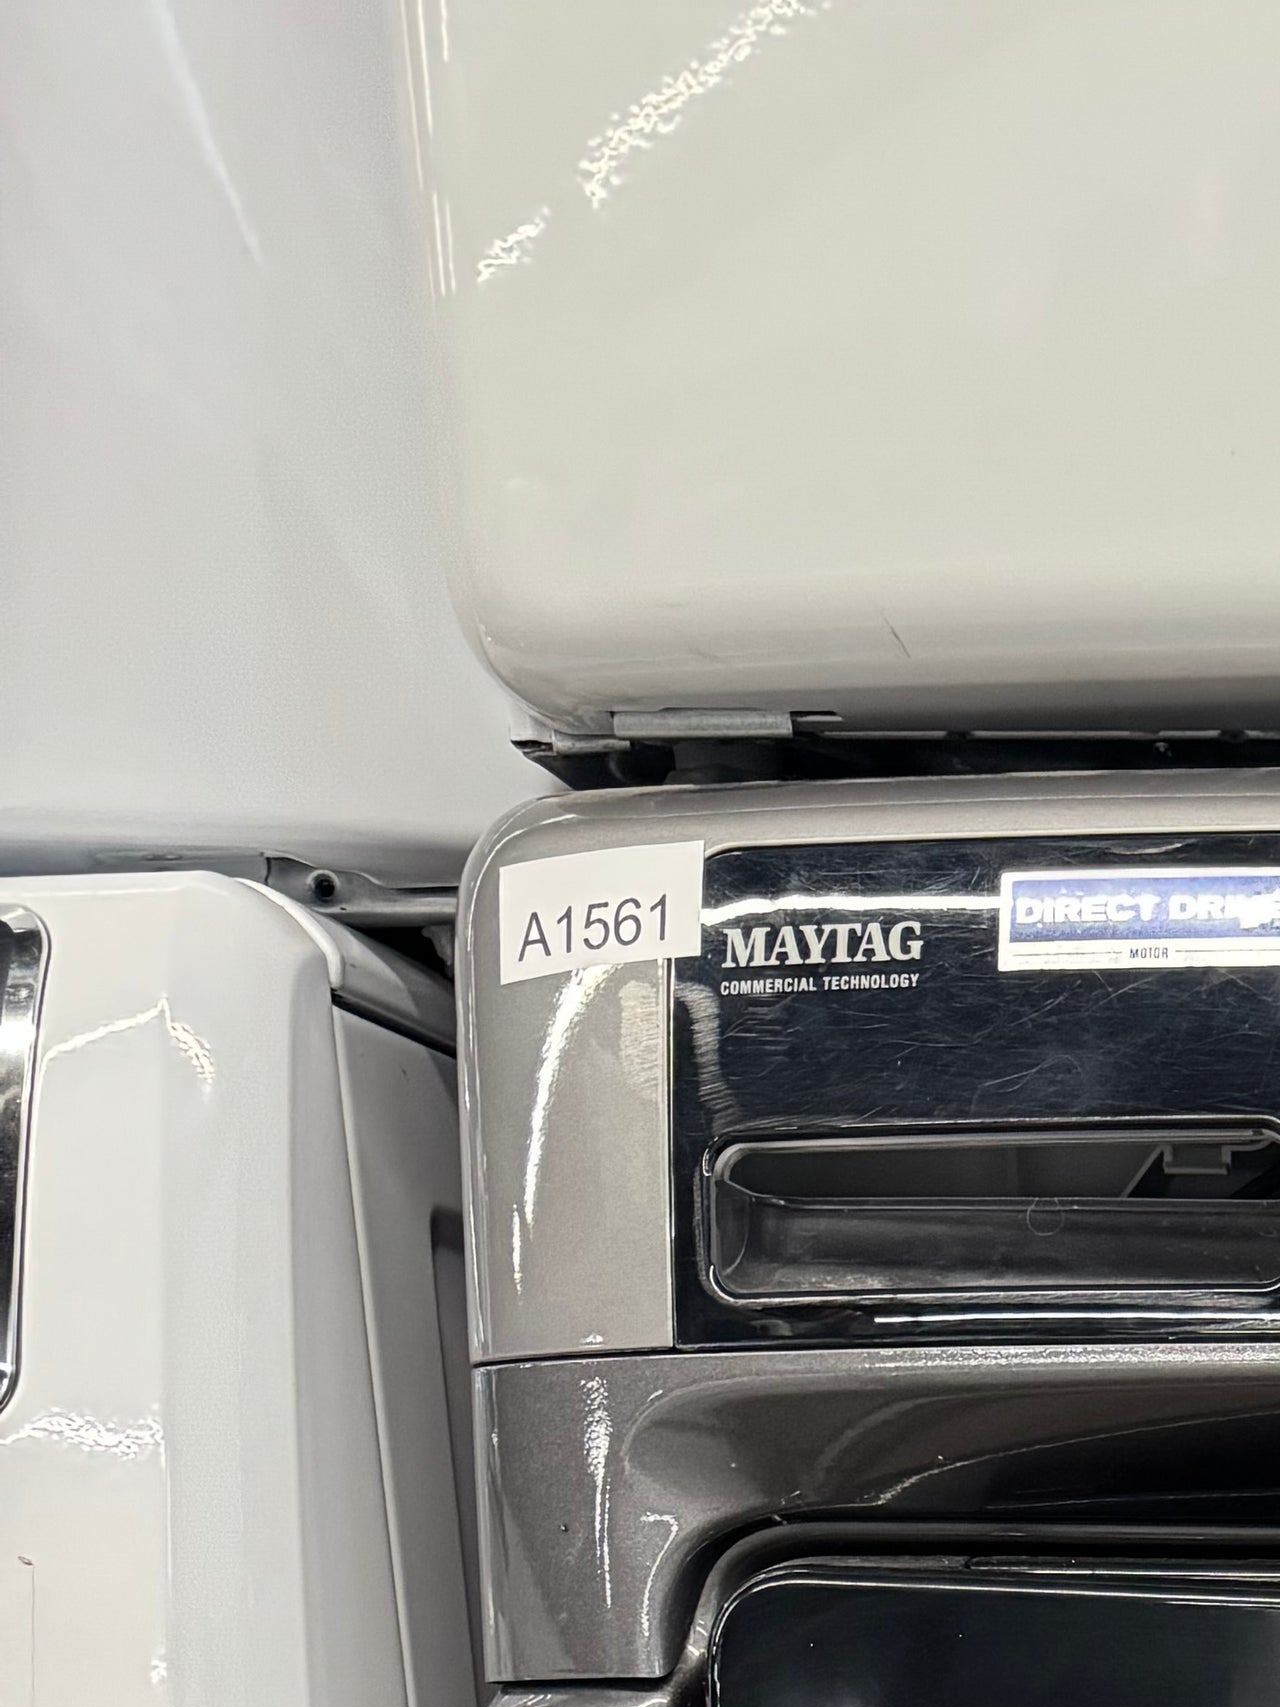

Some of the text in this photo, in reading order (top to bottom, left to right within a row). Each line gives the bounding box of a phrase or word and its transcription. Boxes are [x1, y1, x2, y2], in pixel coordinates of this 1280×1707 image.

[1015, 895, 1160, 923] DIRECT
[518, 894, 669, 962] A1561
[721, 921, 923, 968] MAYTAG
[1129, 947, 1169, 960] MOTOR
[720, 974, 920, 996] COMMERCIAL TECHNOLOGY
